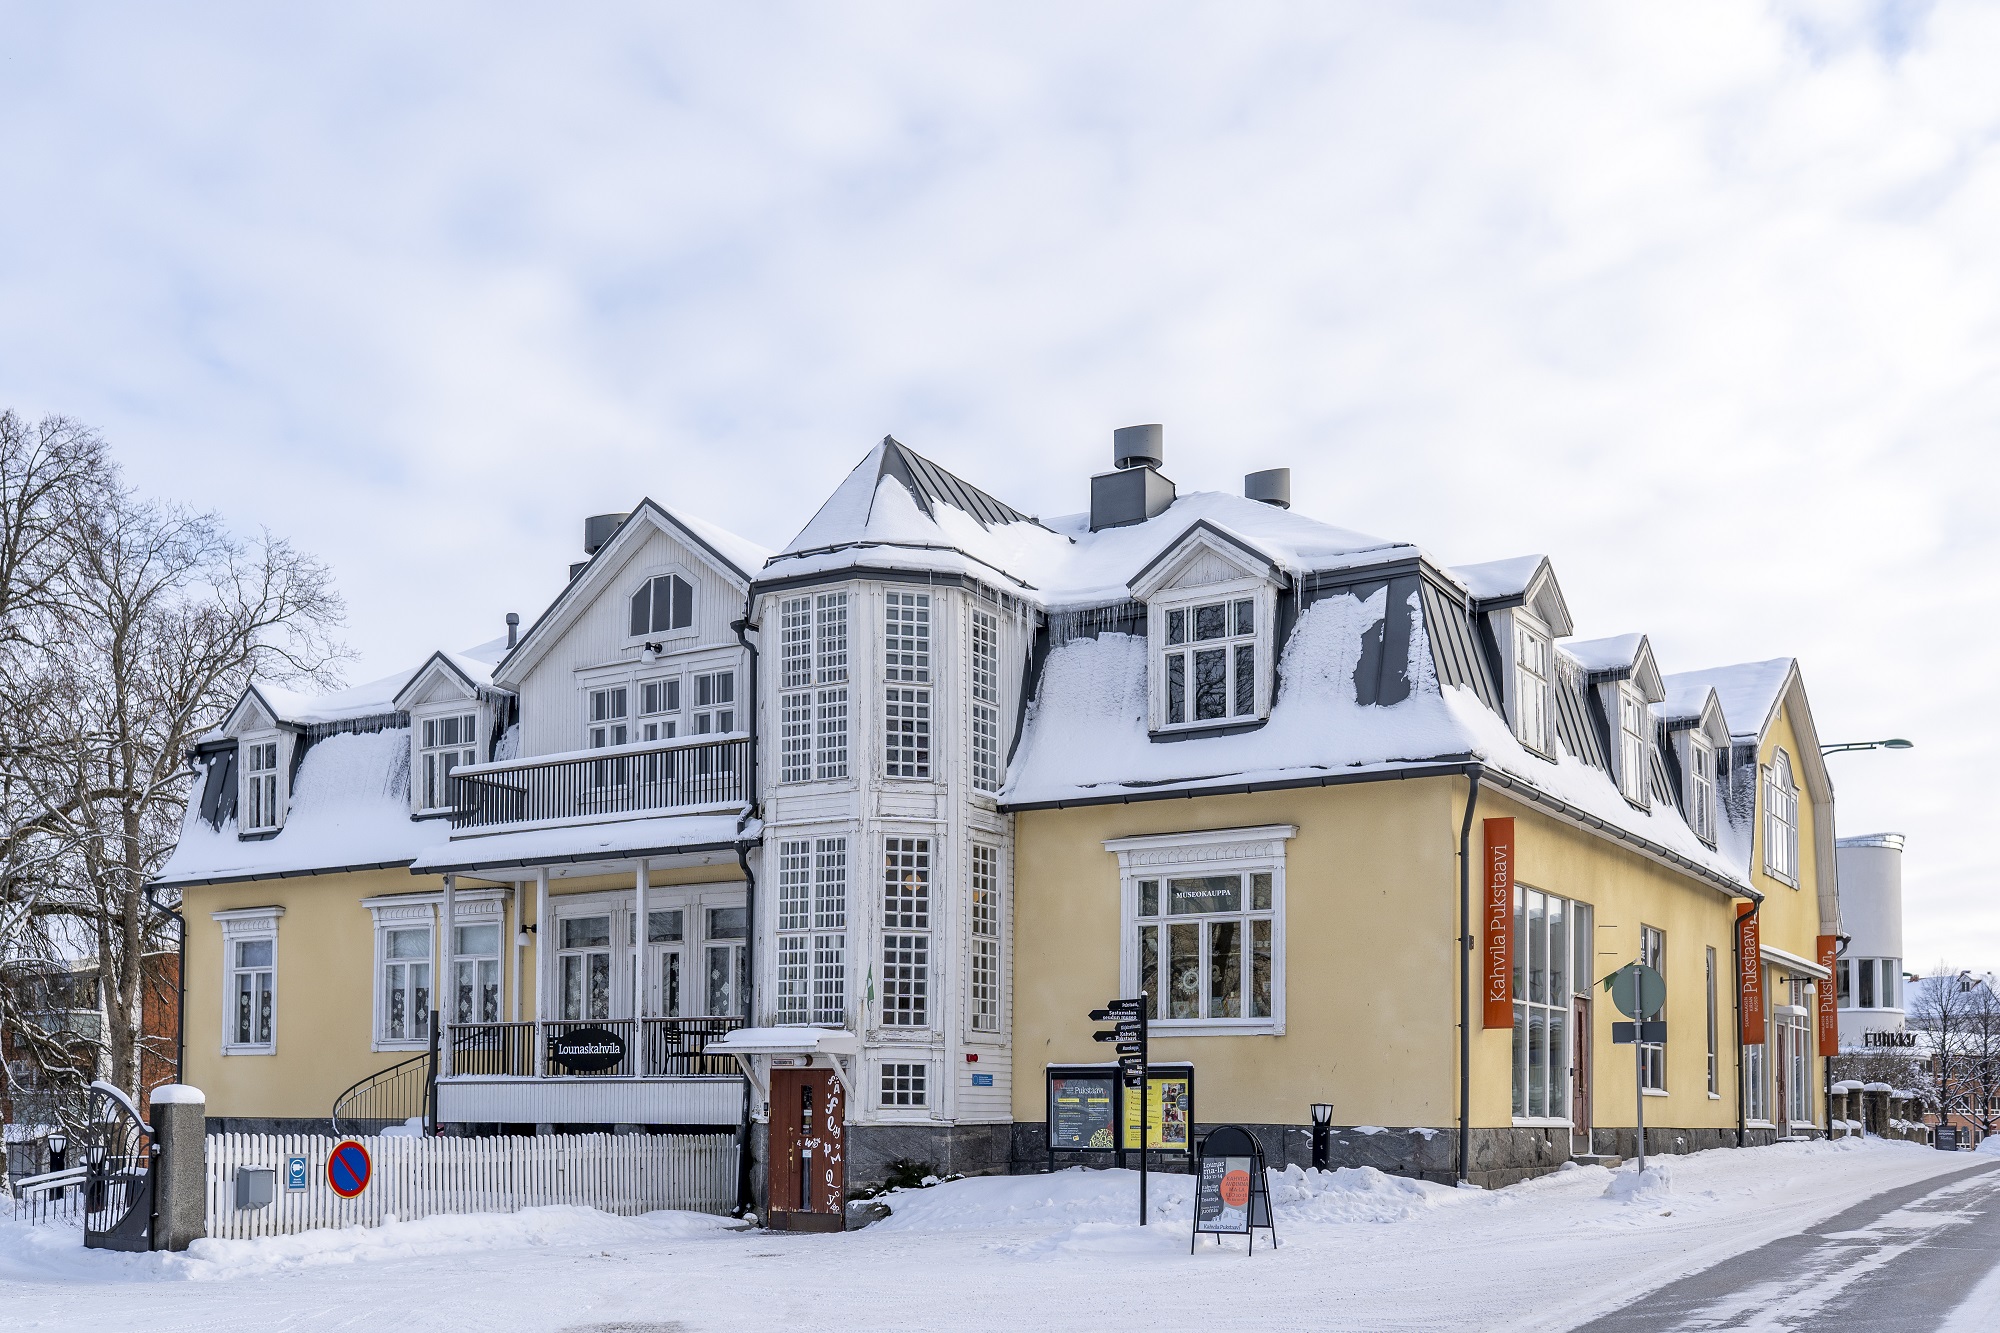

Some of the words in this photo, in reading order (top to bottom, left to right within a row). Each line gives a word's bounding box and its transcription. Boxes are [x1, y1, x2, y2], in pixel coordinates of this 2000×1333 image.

[1490, 844, 1507, 931] Pukstaavi
[1176, 889, 1231, 899] MUSEOKAUPPA
[1490, 934, 1506, 1002] Kahvila
[558, 1042, 621, 1054] Lounaskahvila
[1203, 1166, 1224, 1174] ma-la
